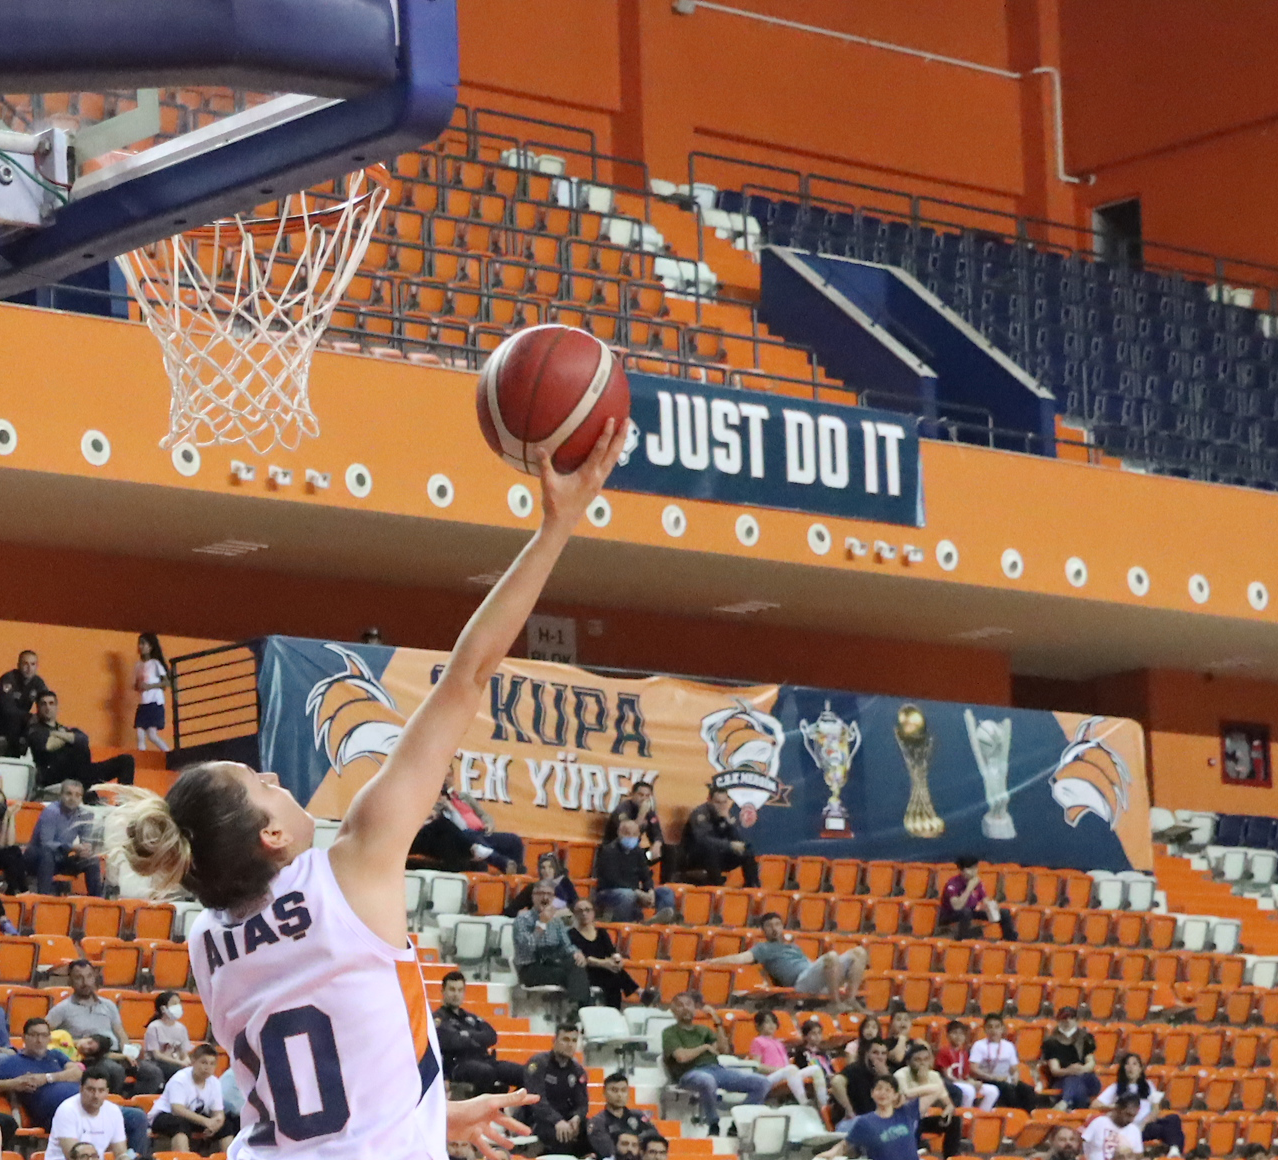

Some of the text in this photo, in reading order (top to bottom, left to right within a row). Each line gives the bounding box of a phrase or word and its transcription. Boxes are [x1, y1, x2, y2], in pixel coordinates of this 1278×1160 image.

[646, 391, 906, 497] JUST DO IT
[538, 627, 564, 645] H-1
[490, 672, 653, 758] KUPA
[454, 748, 513, 804] EK
[233, 1004, 351, 1147] 10
